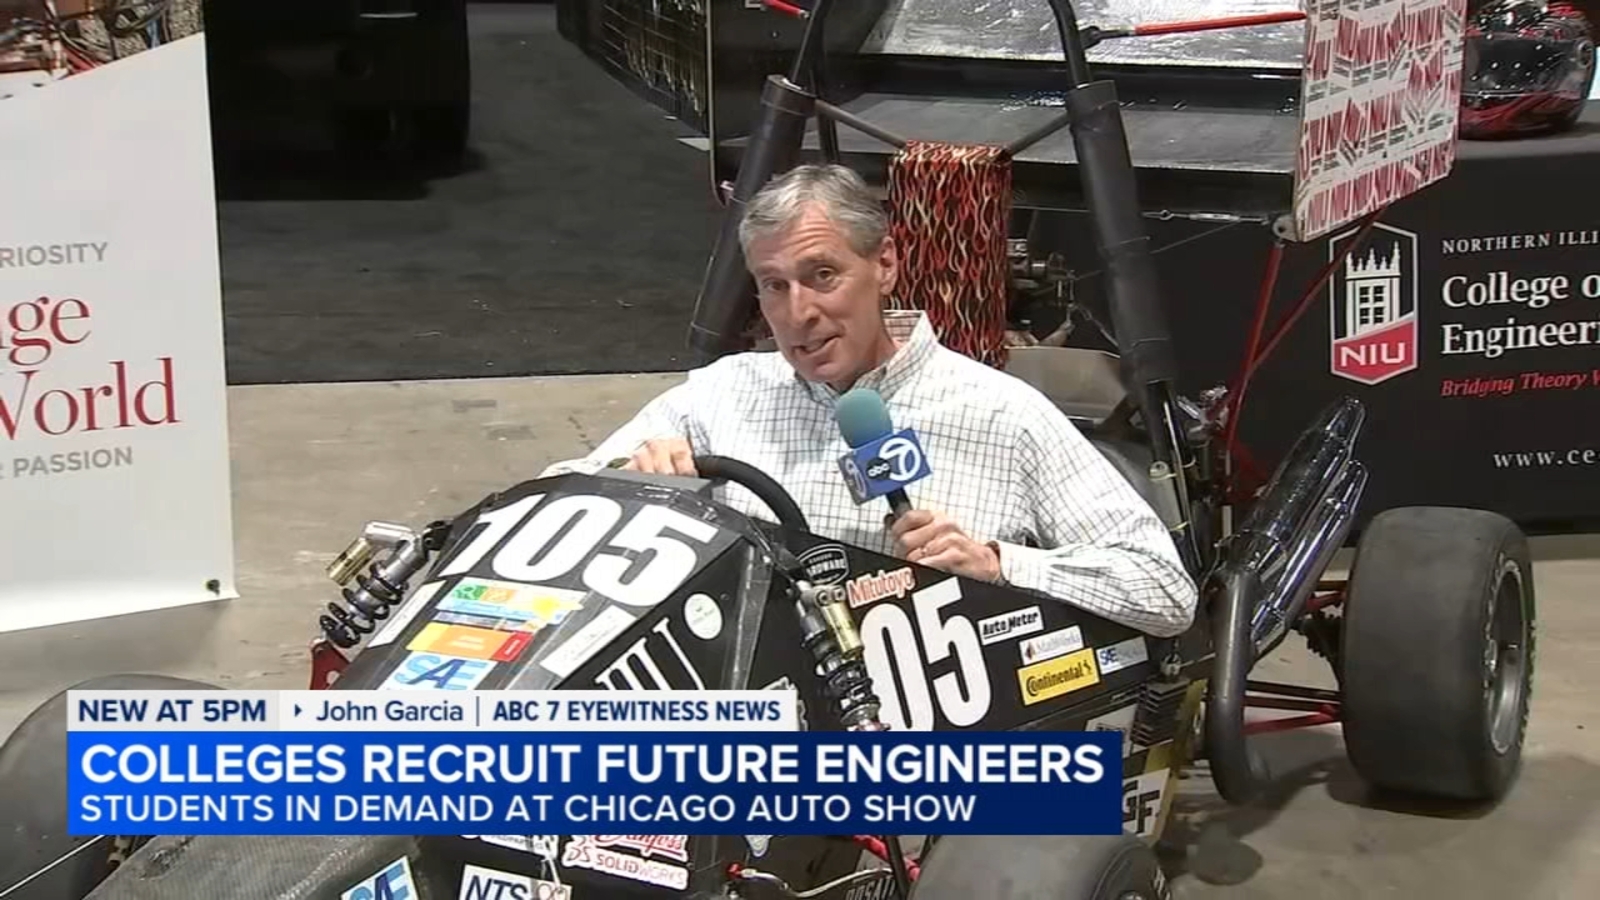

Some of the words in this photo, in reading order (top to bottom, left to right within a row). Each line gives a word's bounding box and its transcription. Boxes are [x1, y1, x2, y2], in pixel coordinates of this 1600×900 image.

[1441, 234, 1550, 254] NORTHERN
[1442, 271, 1569, 308] College
[0, 296, 92, 366] ge
[1441, 318, 1600, 358] Engineer
[1340, 342, 1405, 367] NIU
[1520, 373, 1586, 389] Theory
[13, 447, 133, 478] PASSION
[880, 438, 919, 480] 7
[1493, 449, 1600, 468] www.ce
[438, 493, 719, 607] 105
[848, 569, 914, 605] Mitutoyo
[394, 654, 488, 690] SAE
[1026, 661, 1082, 697] Continental
